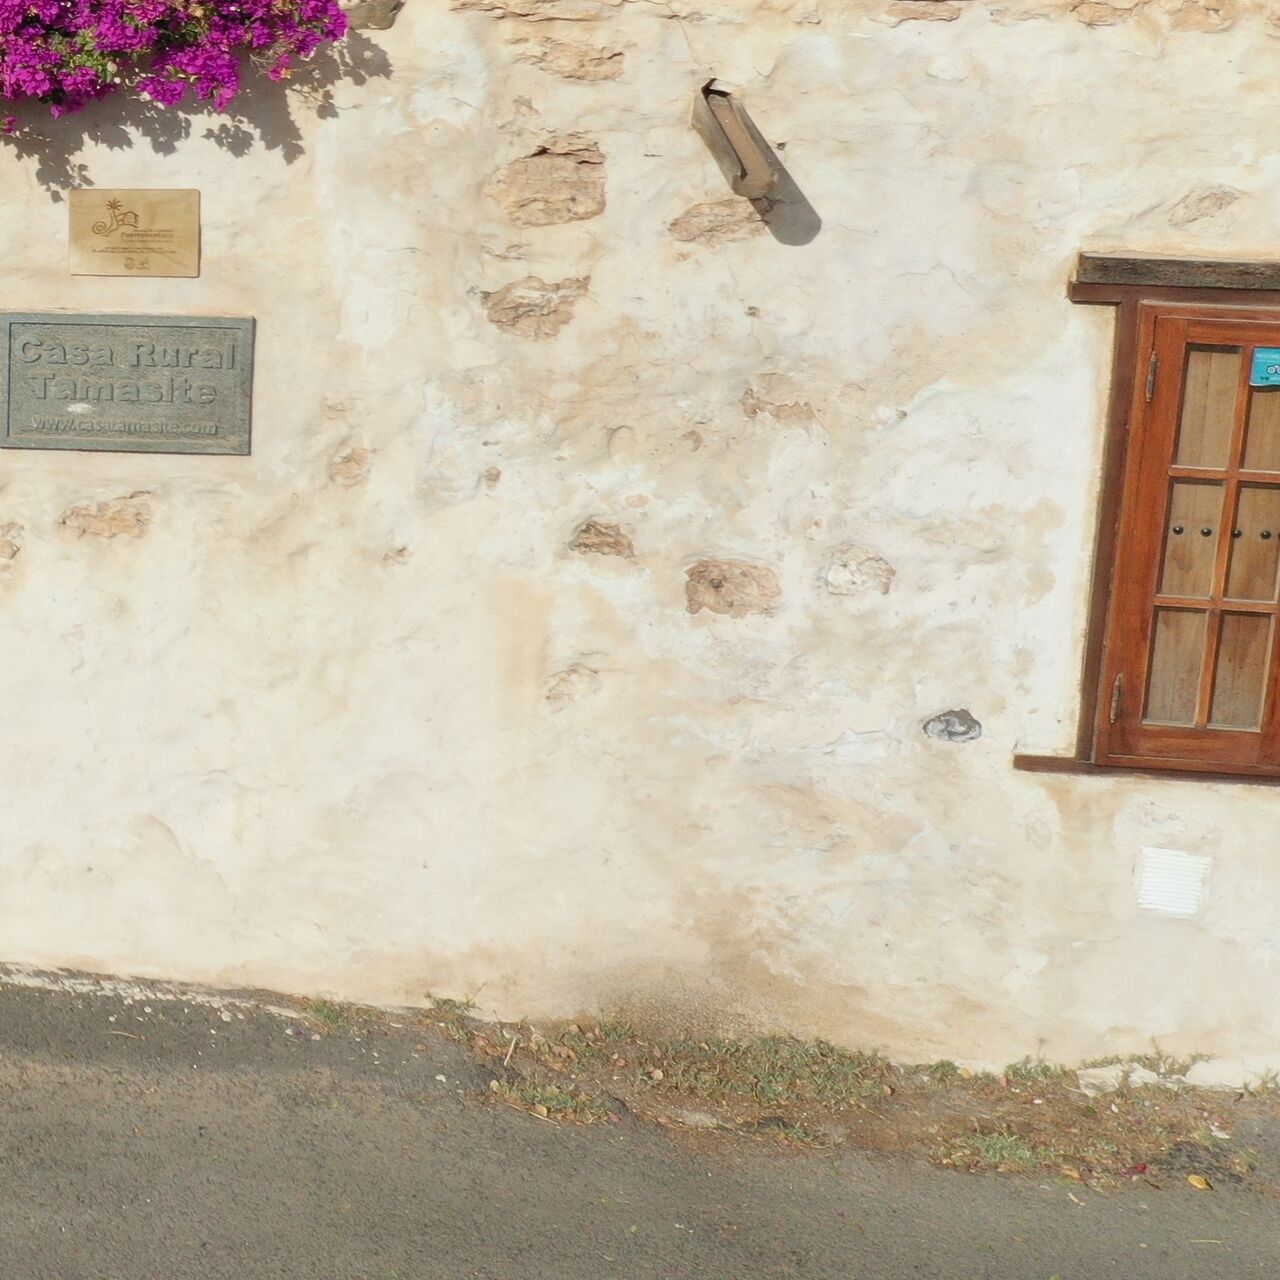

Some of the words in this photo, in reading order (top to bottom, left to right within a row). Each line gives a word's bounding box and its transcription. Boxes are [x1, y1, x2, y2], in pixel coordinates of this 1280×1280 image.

[12, 334, 114, 366] Casa
[129, 339, 237, 370] Rural
[30, 372, 218, 405] Tamasite
